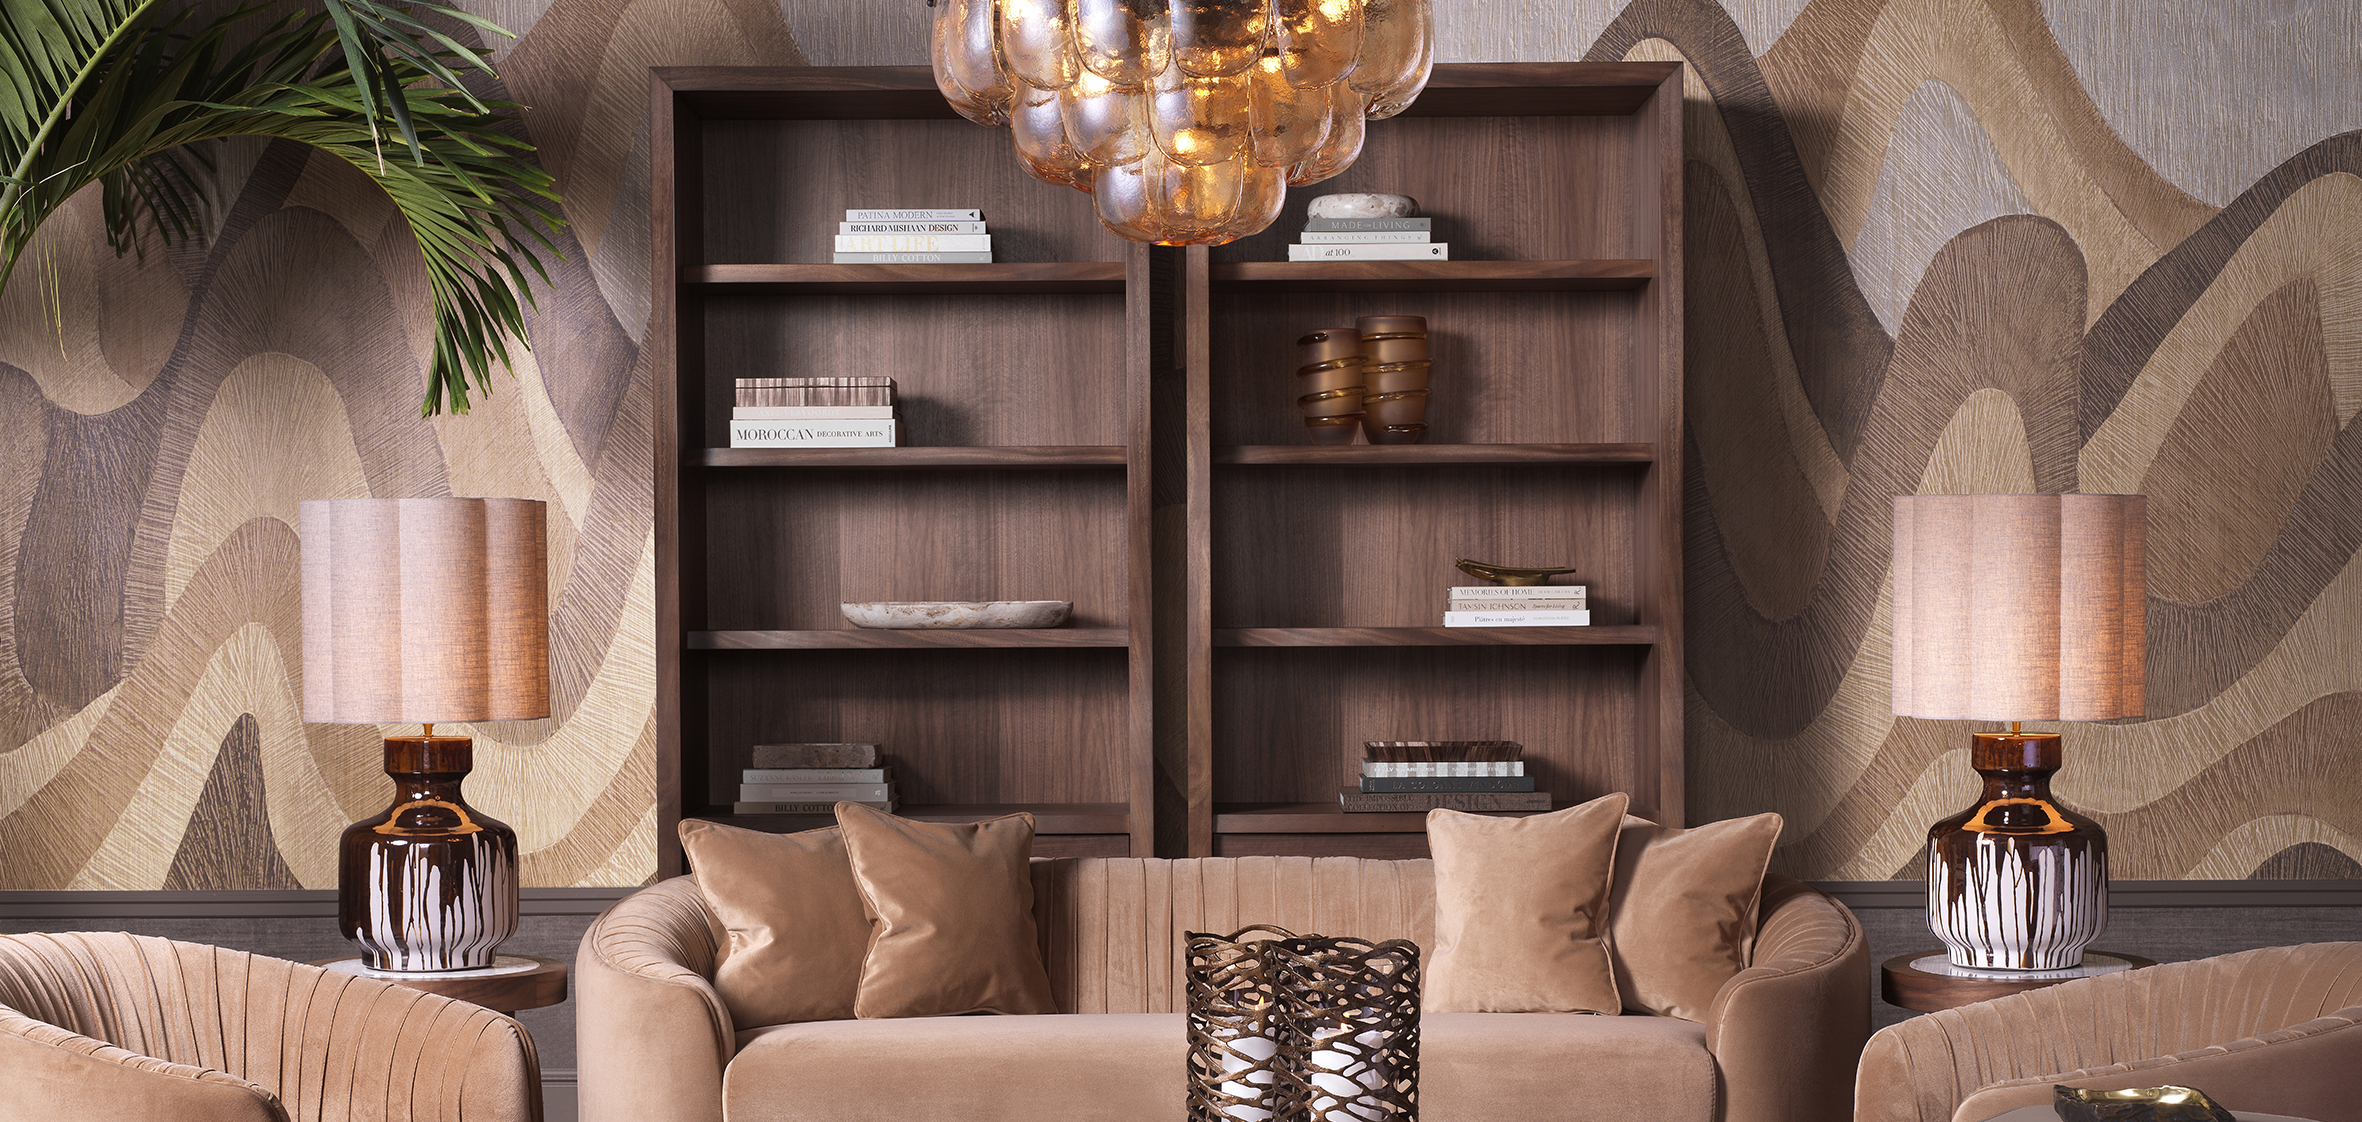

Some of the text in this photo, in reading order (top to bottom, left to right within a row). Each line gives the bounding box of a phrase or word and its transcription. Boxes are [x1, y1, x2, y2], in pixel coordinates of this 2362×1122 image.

[858, 211, 890, 220] PATINA
[893, 211, 933, 220] MODERN
[850, 224, 959, 232] RICHARD MISHAAN DESIGN
[1331, 221, 1362, 229] MADE
[1372, 221, 1410, 229] LIVING
[892, 235, 939, 252] LIFE
[872, 254, 941, 262] BILLY COTTON
[758, 409, 841, 417] AXEL VERVOORDT
[736, 429, 814, 441] MOROCCAN
[1460, 588, 1499, 596] MEMORIES
[1500, 588, 1510, 596] OF
[1511, 588, 1535, 596] HOME
[1459, 603, 1487, 611] TAMSIN
[1392, 780, 1520, 790] LA COLONNE VENDÔME
[1366, 794, 1414, 802] IMPOSSIBLE
[1427, 794, 1503, 810] DESIGN
[775, 804, 836, 812] BILLY COTTO
